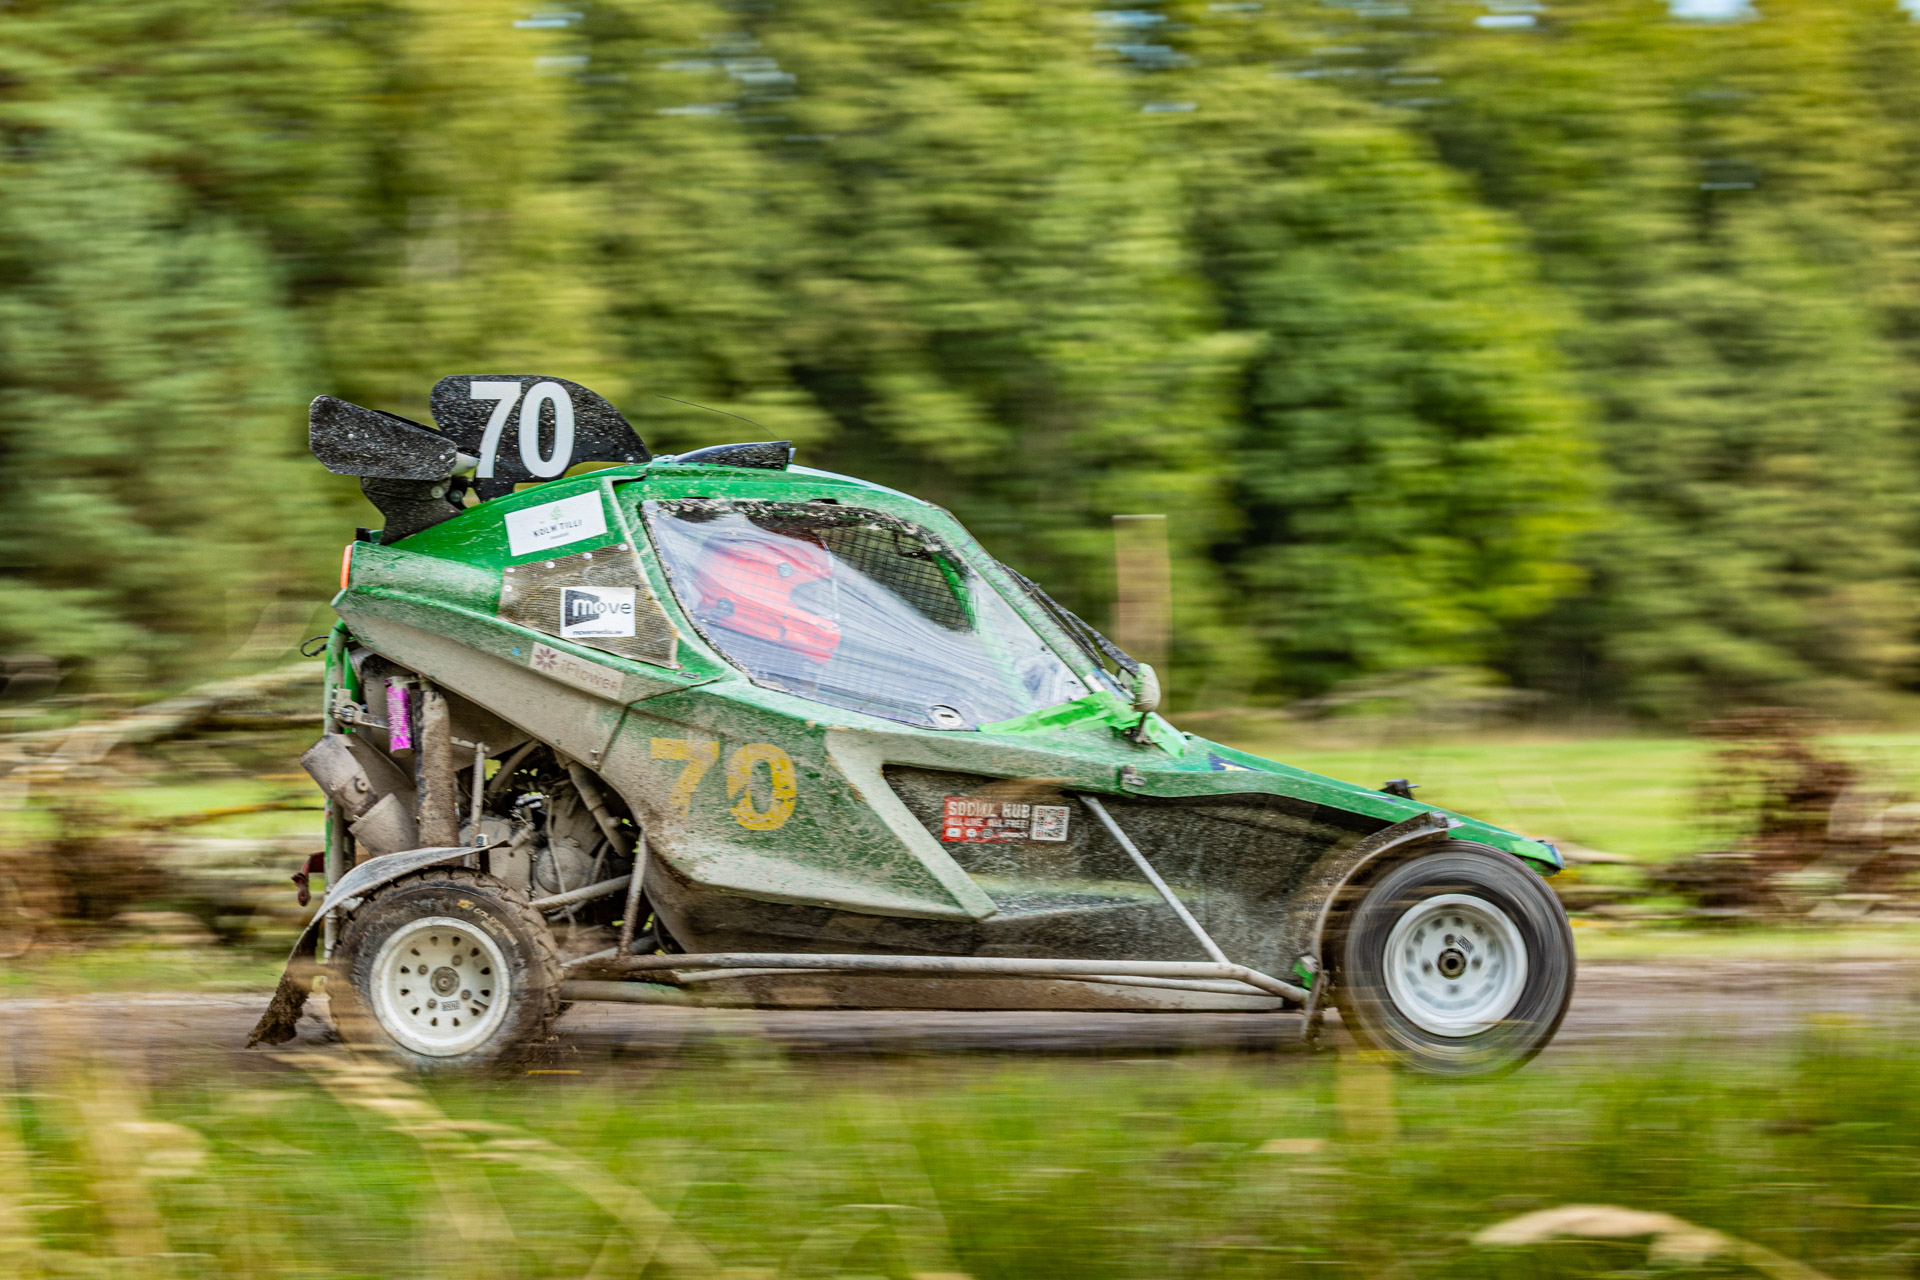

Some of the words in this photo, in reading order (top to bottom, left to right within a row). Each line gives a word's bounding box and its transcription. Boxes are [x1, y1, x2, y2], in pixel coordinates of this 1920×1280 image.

[470, 381, 574, 478] 70
[572, 599, 632, 616] move
[651, 737, 797, 831] 70
[1002, 804, 1030, 818] HUB
